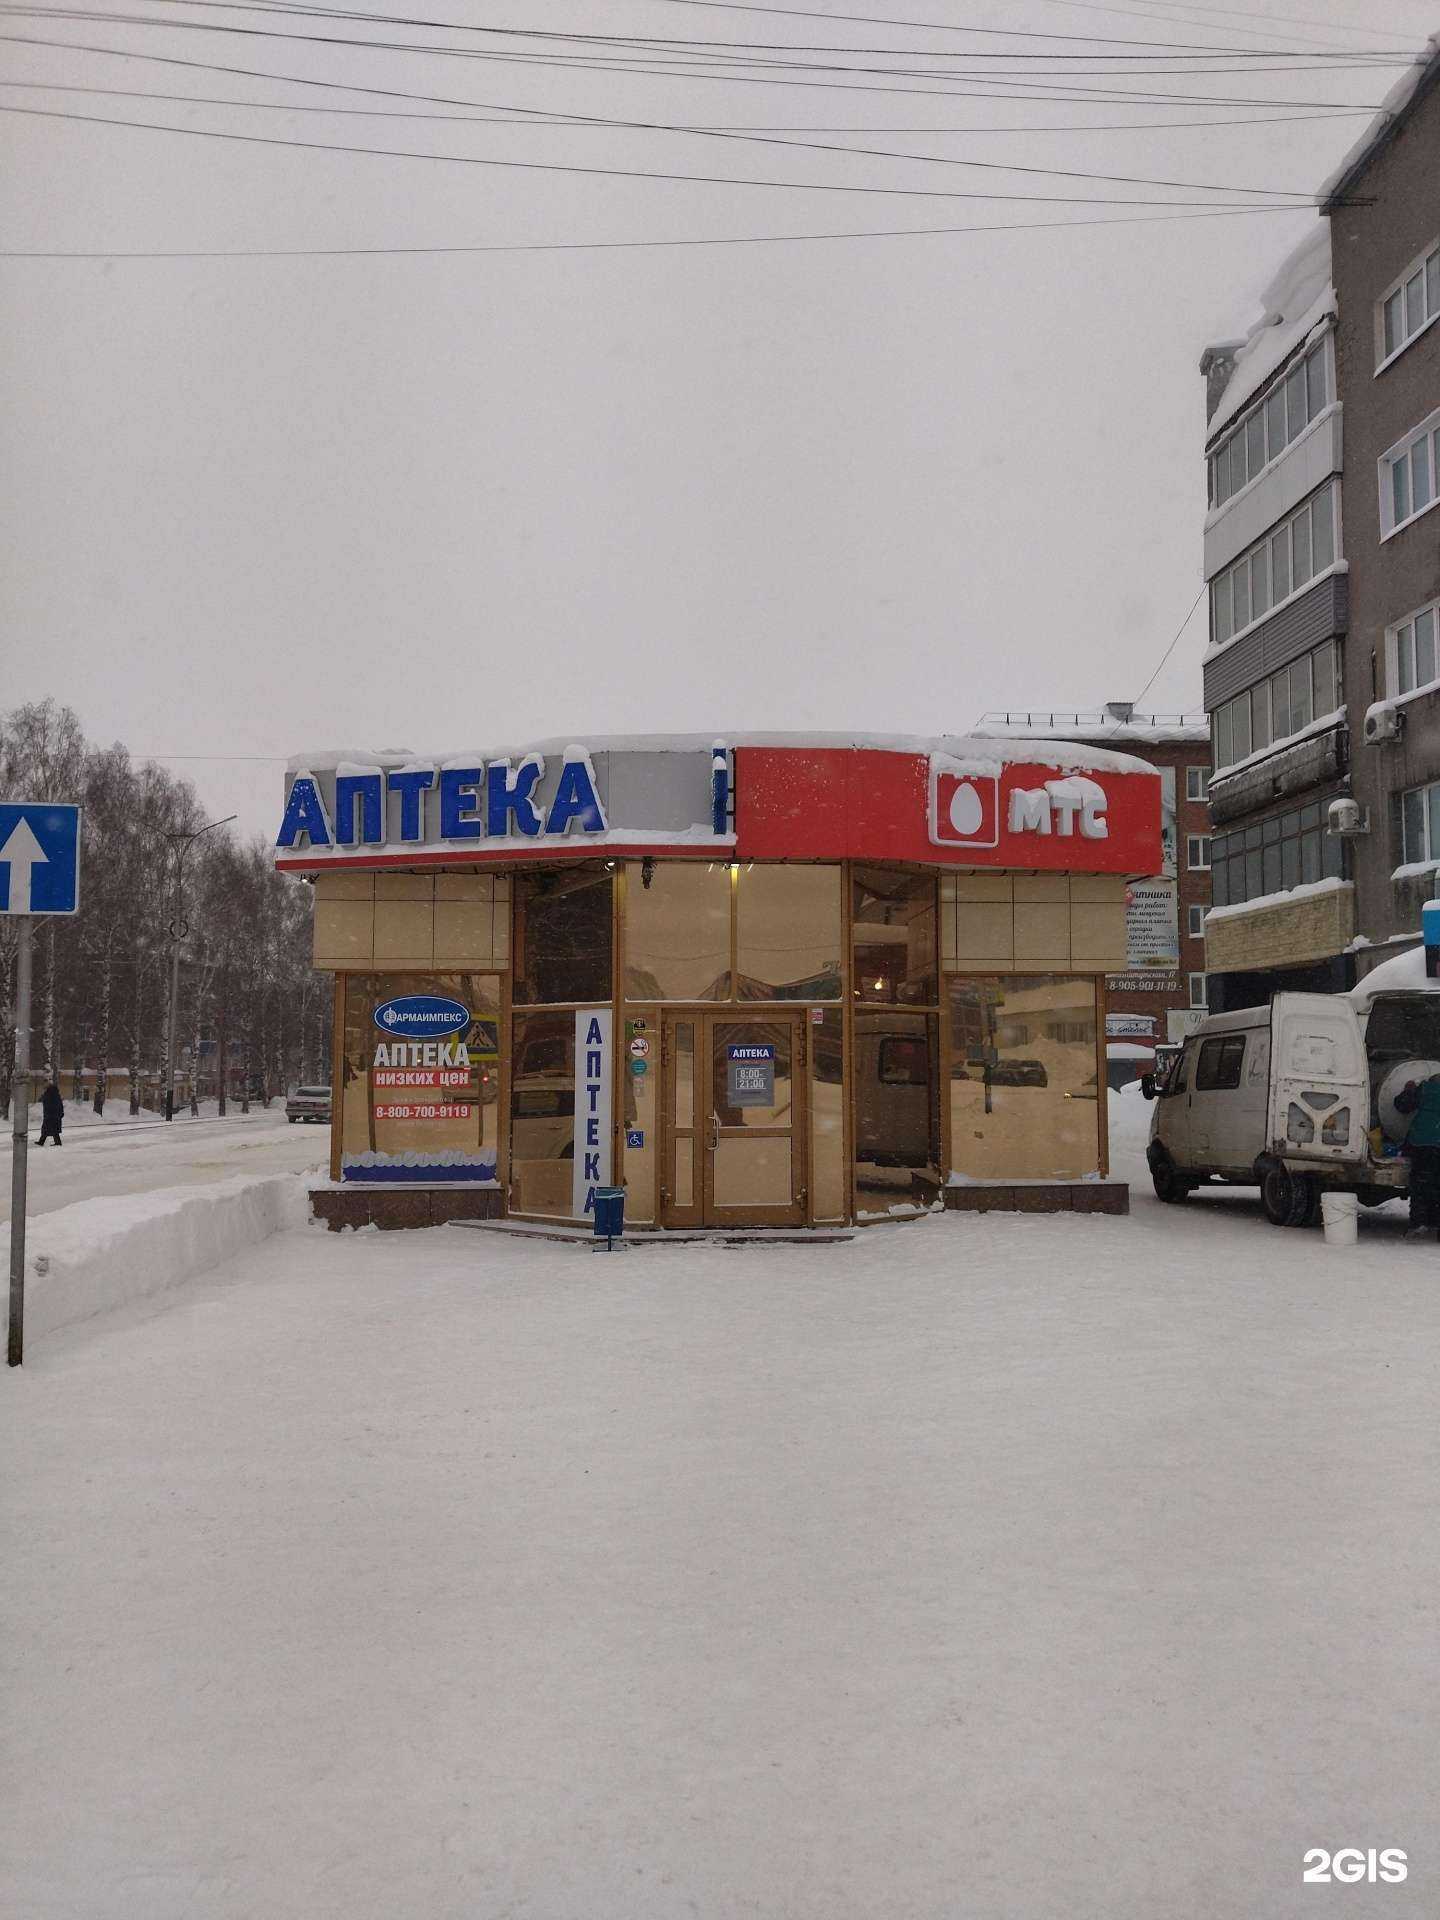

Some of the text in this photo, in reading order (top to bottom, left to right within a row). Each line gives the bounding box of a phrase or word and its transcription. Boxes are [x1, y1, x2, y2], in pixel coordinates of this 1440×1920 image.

[275, 755, 605, 848] АПТЕКА
[1009, 782, 1109, 839] МТС
[383, 1007, 463, 1026] ФАРМАИМПЕКС
[374, 1043, 470, 1067] АПТЕКА
[732, 1048, 770, 1058] АПТЕКА
[376, 1072, 469, 1088] низких цен
[376, 1106, 468, 1119] 8-800-700-9119
